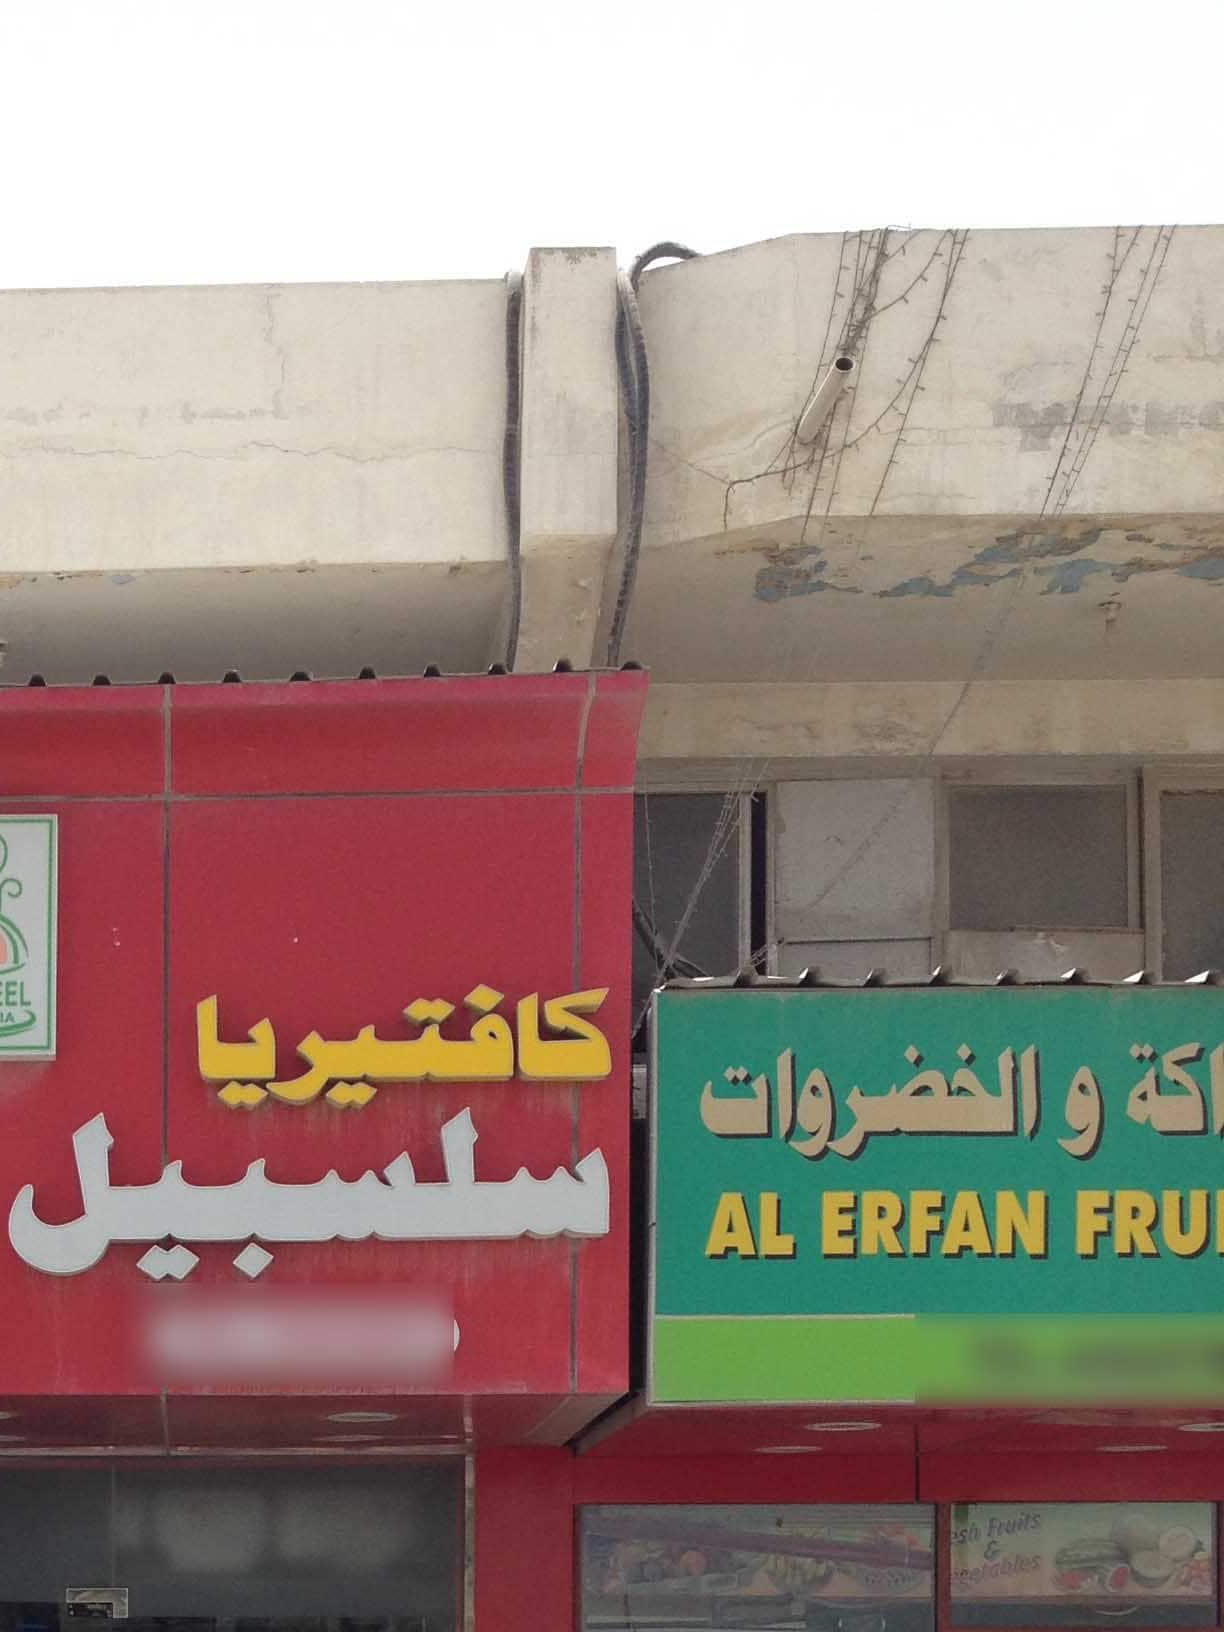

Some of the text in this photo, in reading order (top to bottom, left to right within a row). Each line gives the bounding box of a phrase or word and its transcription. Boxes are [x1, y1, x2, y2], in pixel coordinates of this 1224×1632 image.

[196, 984, 612, 1109] كافتيريا
[699, 1043, 1040, 1161] الخضروات
[1056, 1064, 1104, 1160] و
[8, 1106, 610, 1281] سلسبيل
[705, 1191, 797, 1259] AL
[821, 1190, 1048, 1259] ERFAN
